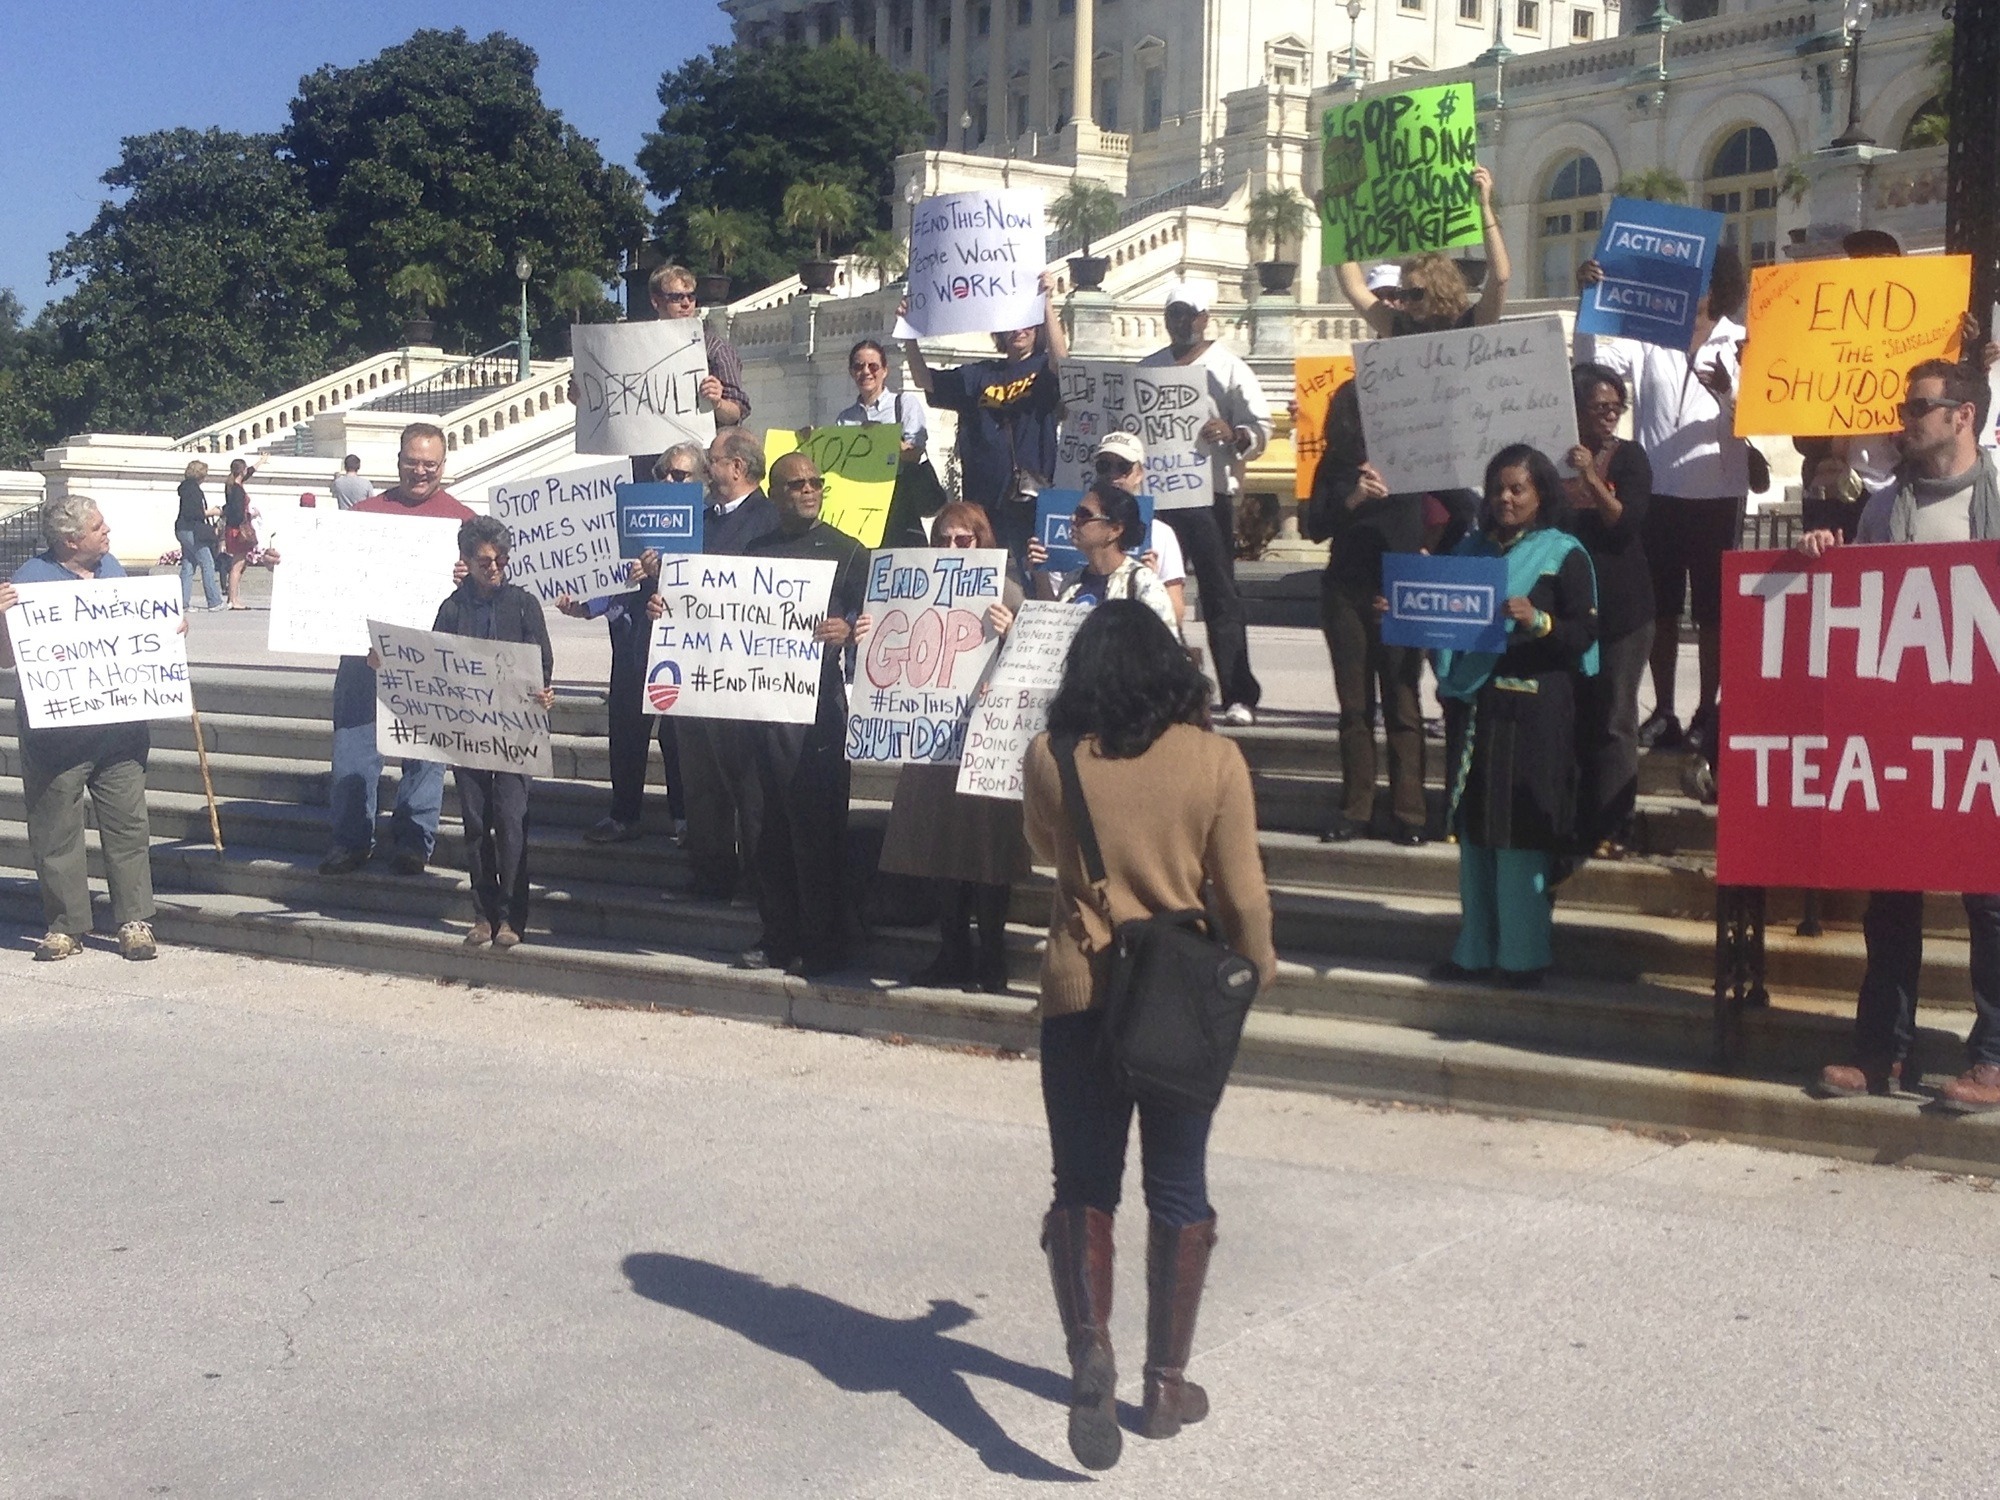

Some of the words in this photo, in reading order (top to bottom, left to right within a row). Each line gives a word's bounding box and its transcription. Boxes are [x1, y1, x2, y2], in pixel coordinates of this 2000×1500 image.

[1376, 126, 1475, 175] HOLDING
[1345, 206, 1478, 260] HOSTAGE
[1616, 232, 1691, 259] ACTION
[955, 237, 1020, 264] Want
[933, 270, 1015, 302] WORK!
[1607, 287, 1677, 313] ACTION
[1808, 281, 1916, 331] END
[1831, 342, 1873, 363] THE
[583, 368, 705, 418] DEFAULT
[1103, 373, 1123, 410] I
[1134, 378, 1199, 414] DID
[1767, 358, 1900, 404] SHUTDO
[1145, 414, 1199, 445] MY
[496, 488, 540, 518] STOP
[581, 511, 615, 533] WIT
[630, 513, 683, 528] ACTION
[536, 576, 587, 601] WANT
[667, 559, 689, 586] I
[701, 568, 737, 588] AM
[753, 566, 811, 602] NOT
[867, 554, 929, 602] END
[933, 558, 998, 608] THE
[17, 600, 62, 627] THE
[75, 595, 181, 621] AMERICAN
[660, 597, 673, 619] A
[680, 595, 776, 626] POLITICAL
[1402, 591, 1481, 613] ACTION
[18, 636, 119, 662] ECONOMY
[128, 633, 160, 655] IS
[378, 634, 425, 664] END
[435, 648, 486, 676] THE
[656, 626, 676, 646] I
[682, 632, 711, 653] AM
[720, 632, 733, 652] A
[740, 629, 820, 660] VETERAN
[27, 667, 77, 691] NOT
[88, 667, 104, 688] A
[106, 662, 190, 686] HOSTAGE
[380, 668, 494, 705] #TEAPARTY
[691, 664, 815, 697] #ENDTHISNOW
[869, 689, 973, 716] #ENDTHISN
[978, 689, 1012, 709] JUST
[983, 712, 1008, 731] YOU
[1013, 712, 1040, 731] ARE
[971, 732, 1018, 752] DOING
[965, 752, 1009, 770] DON'T
[969, 771, 1006, 791] FROM
